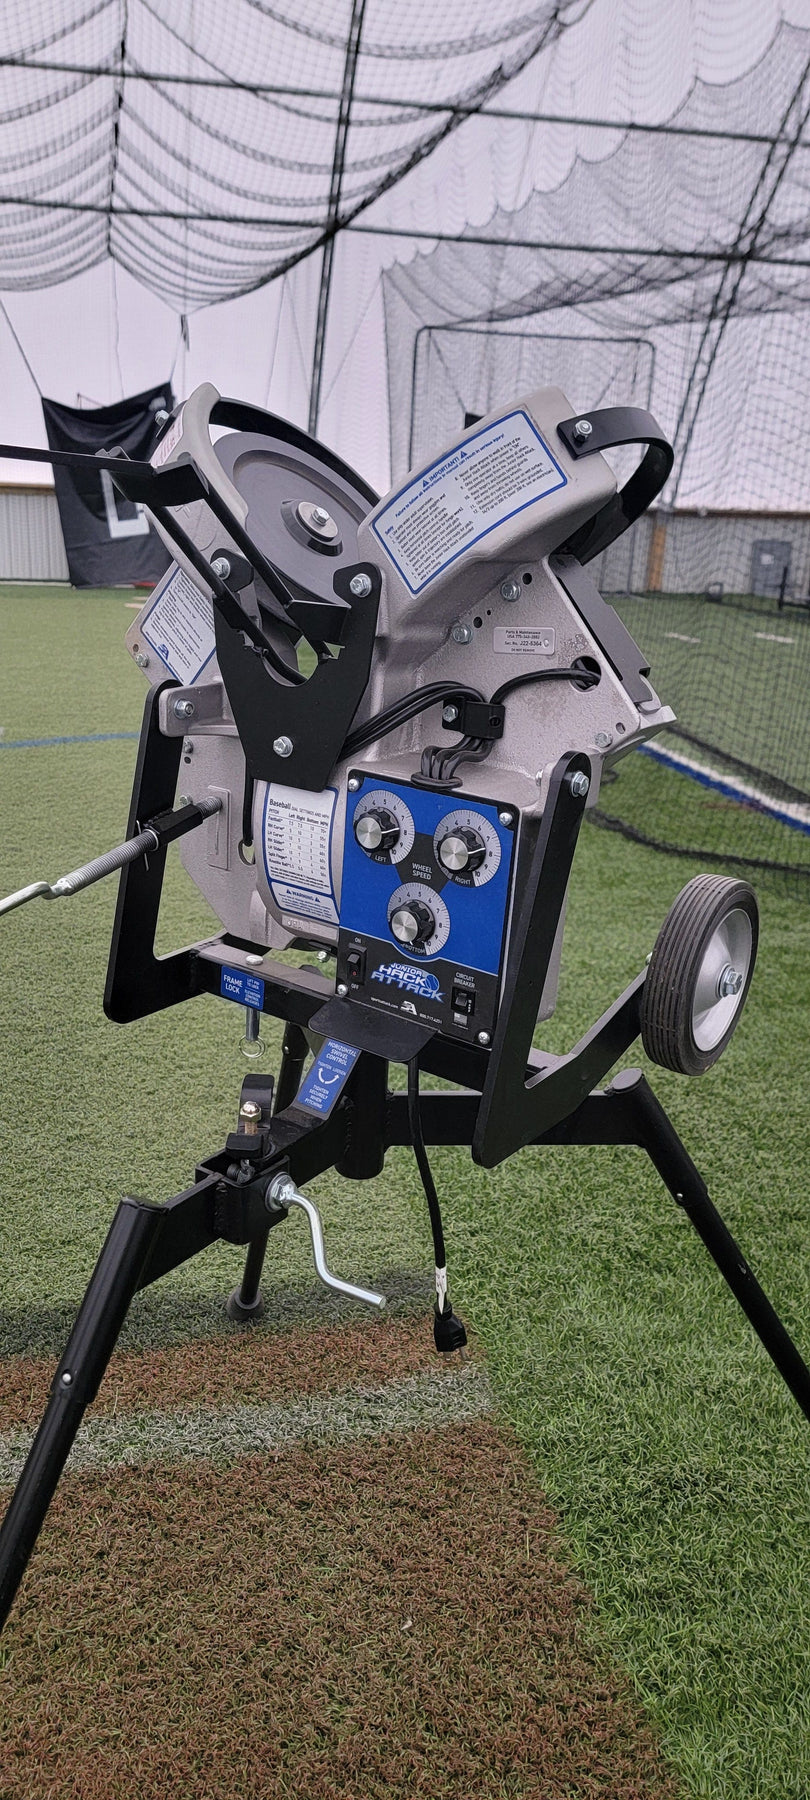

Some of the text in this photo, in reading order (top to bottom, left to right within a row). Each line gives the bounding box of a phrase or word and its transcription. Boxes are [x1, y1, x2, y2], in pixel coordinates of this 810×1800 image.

[428, 456, 460, 482] IMPORTANT!
[270, 798, 291, 809] Baseball
[412, 862, 432, 874] WHEEL
[412, 870, 431, 880] SPEED
[455, 876, 471, 885] RIGHT
[406, 945, 425, 954] BOTTOM
[390, 962, 422, 976] JUNIOR
[224, 974, 243, 987] FRAME
[379, 964, 425, 986] HACK
[456, 972, 474, 982] CIRCUIT
[370, 971, 446, 1003] ATTACK
[454, 977, 475, 988] BREAKER
[226, 983, 240, 994] LOCK
[328, 1041, 356, 1057] HORIZONTAL
[331, 1049, 348, 1059] SWIVEL
[326, 1054, 347, 1066] CONTROL
[318, 1061, 346, 1076] TIGHTEN LOOSEN
[309, 1089, 328, 1100] SECURELY
[313, 1085, 329, 1095] TIGHTEN
[305, 1098, 322, 1108] PITCHING
